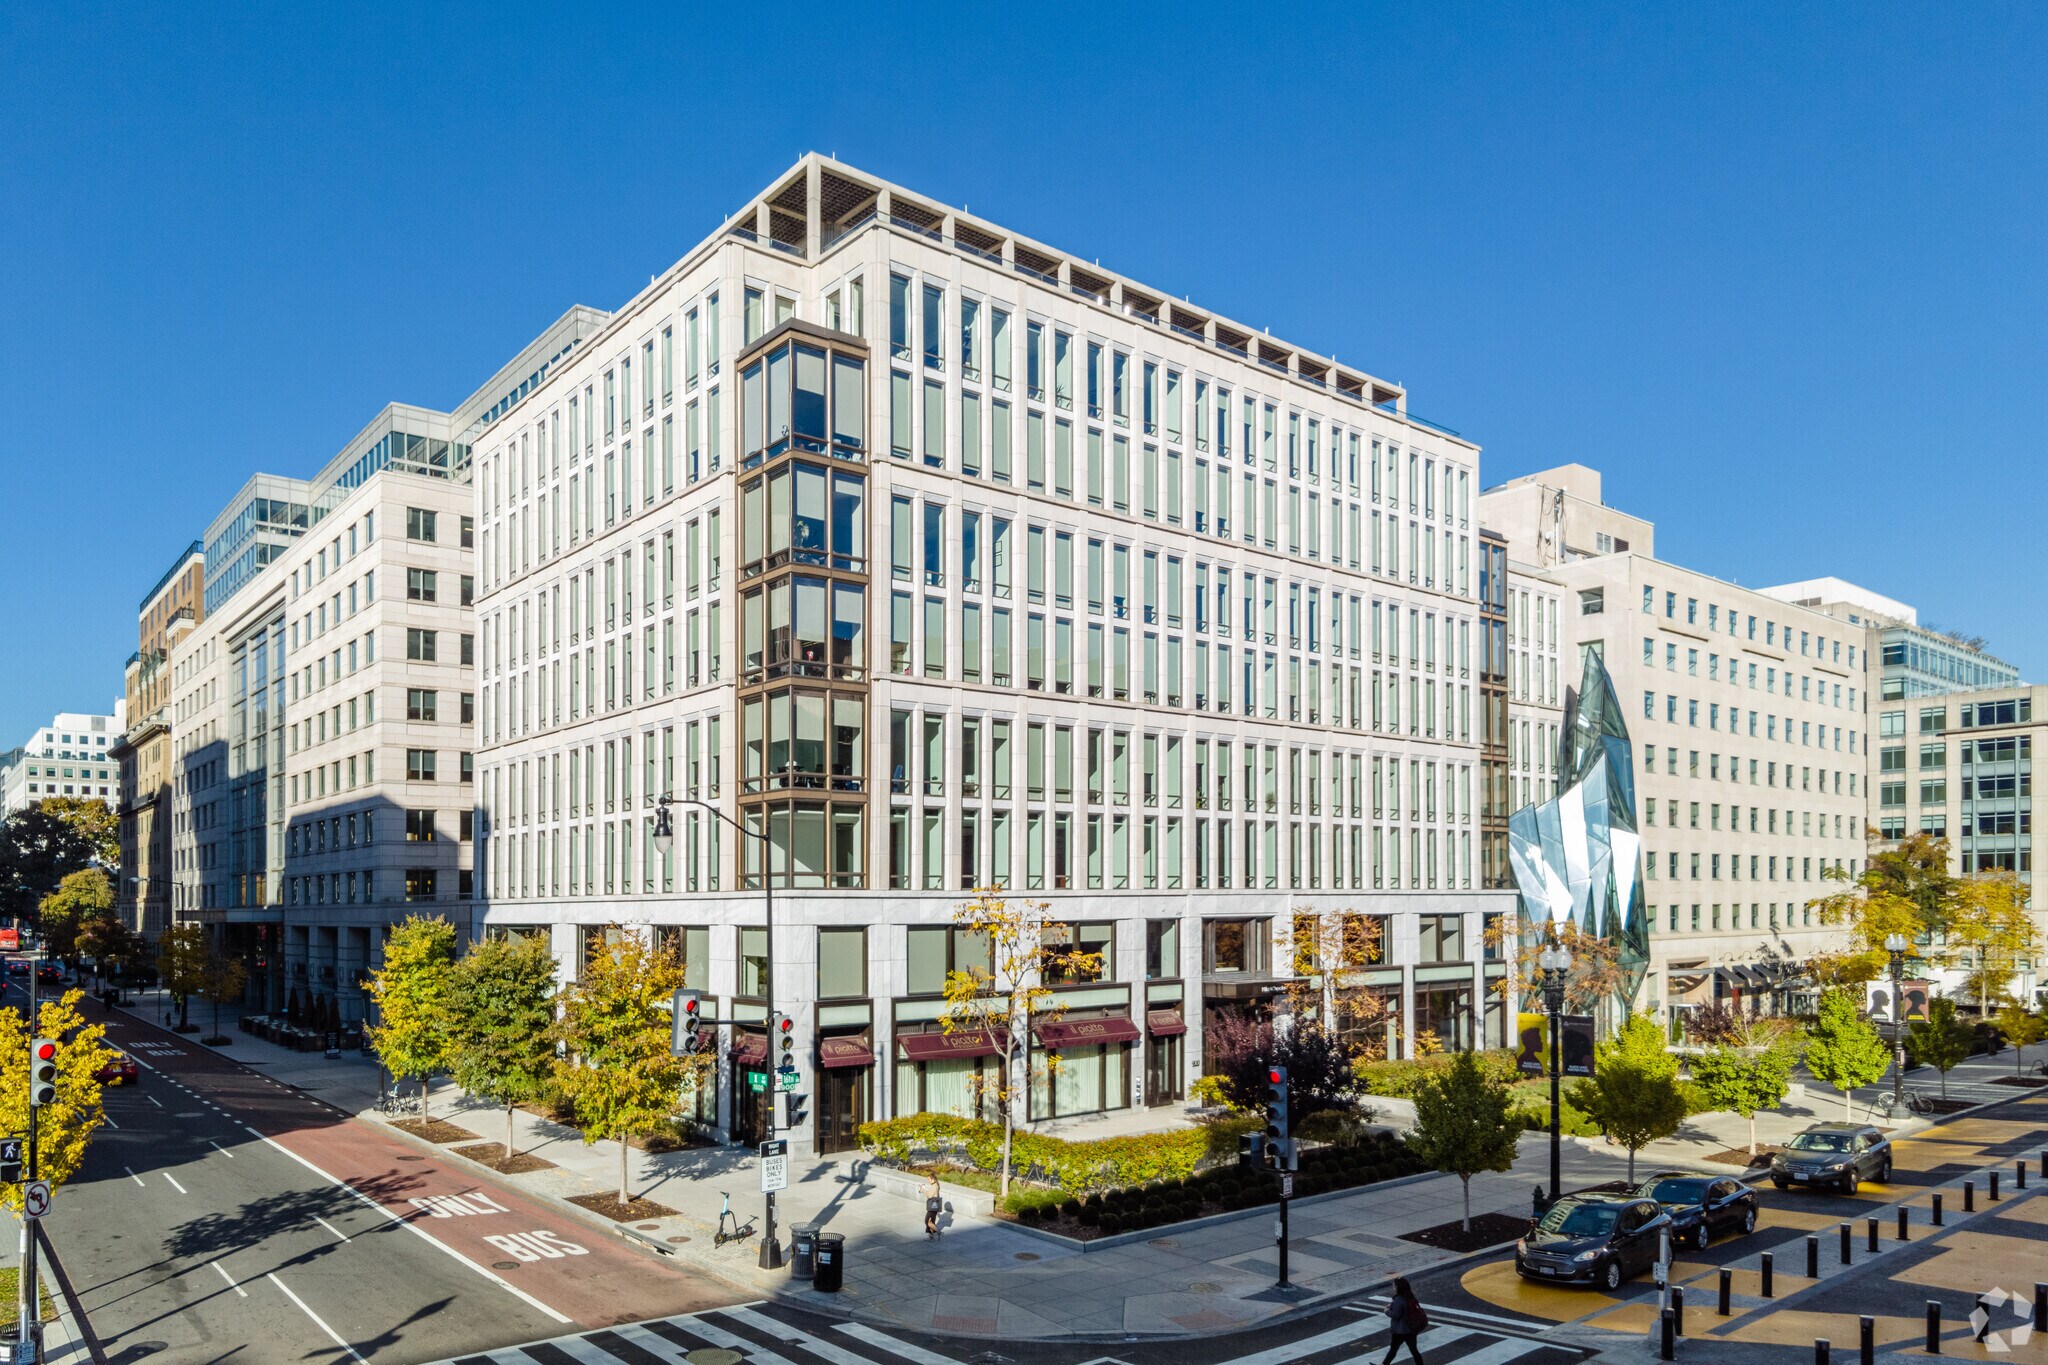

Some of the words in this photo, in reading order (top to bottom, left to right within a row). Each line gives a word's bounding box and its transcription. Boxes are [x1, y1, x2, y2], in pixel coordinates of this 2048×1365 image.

[1069, 1024, 1078, 1034] il
[1078, 1024, 1105, 1035] piatto
[940, 1036, 949, 1046] il
[950, 1035, 980, 1048] piatto
[827, 1044, 833, 1053] il
[834, 1044, 860, 1054] piatto
[408, 1192, 511, 1218] ONLY
[483, 1230, 590, 1262] BUS
